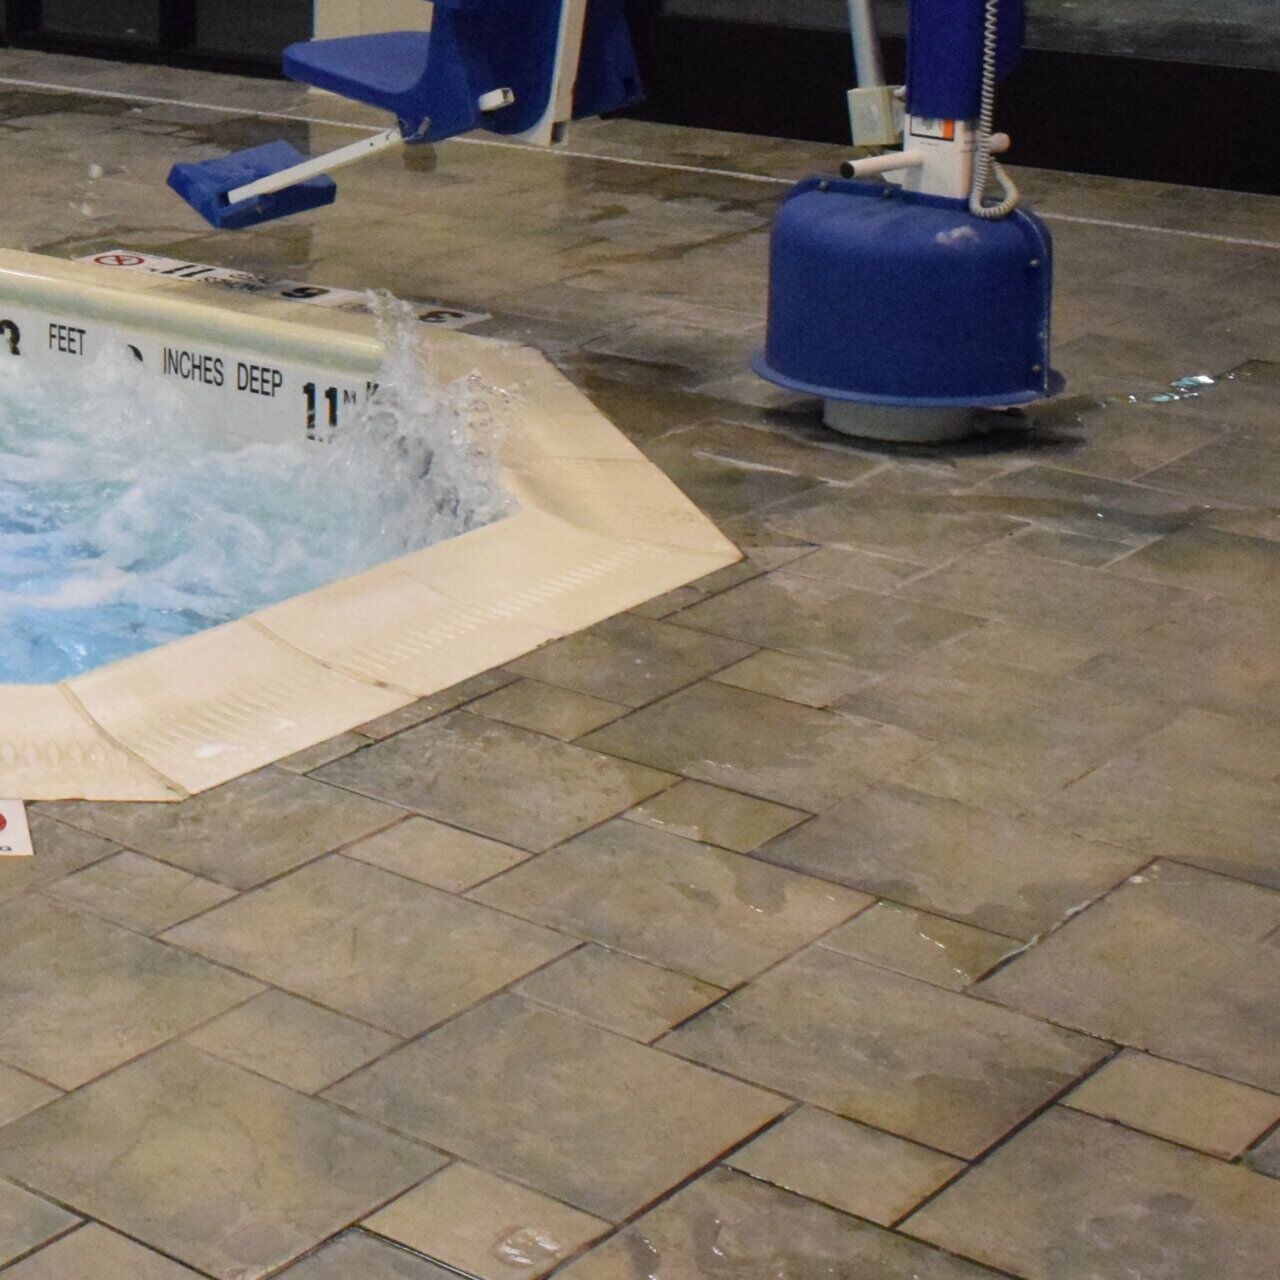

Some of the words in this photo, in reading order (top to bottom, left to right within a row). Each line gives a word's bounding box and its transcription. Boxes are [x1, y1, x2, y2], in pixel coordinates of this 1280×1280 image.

[48, 323, 87, 355] FEET
[163, 347, 225, 387] INCHES
[237, 362, 283, 398] DEEP
